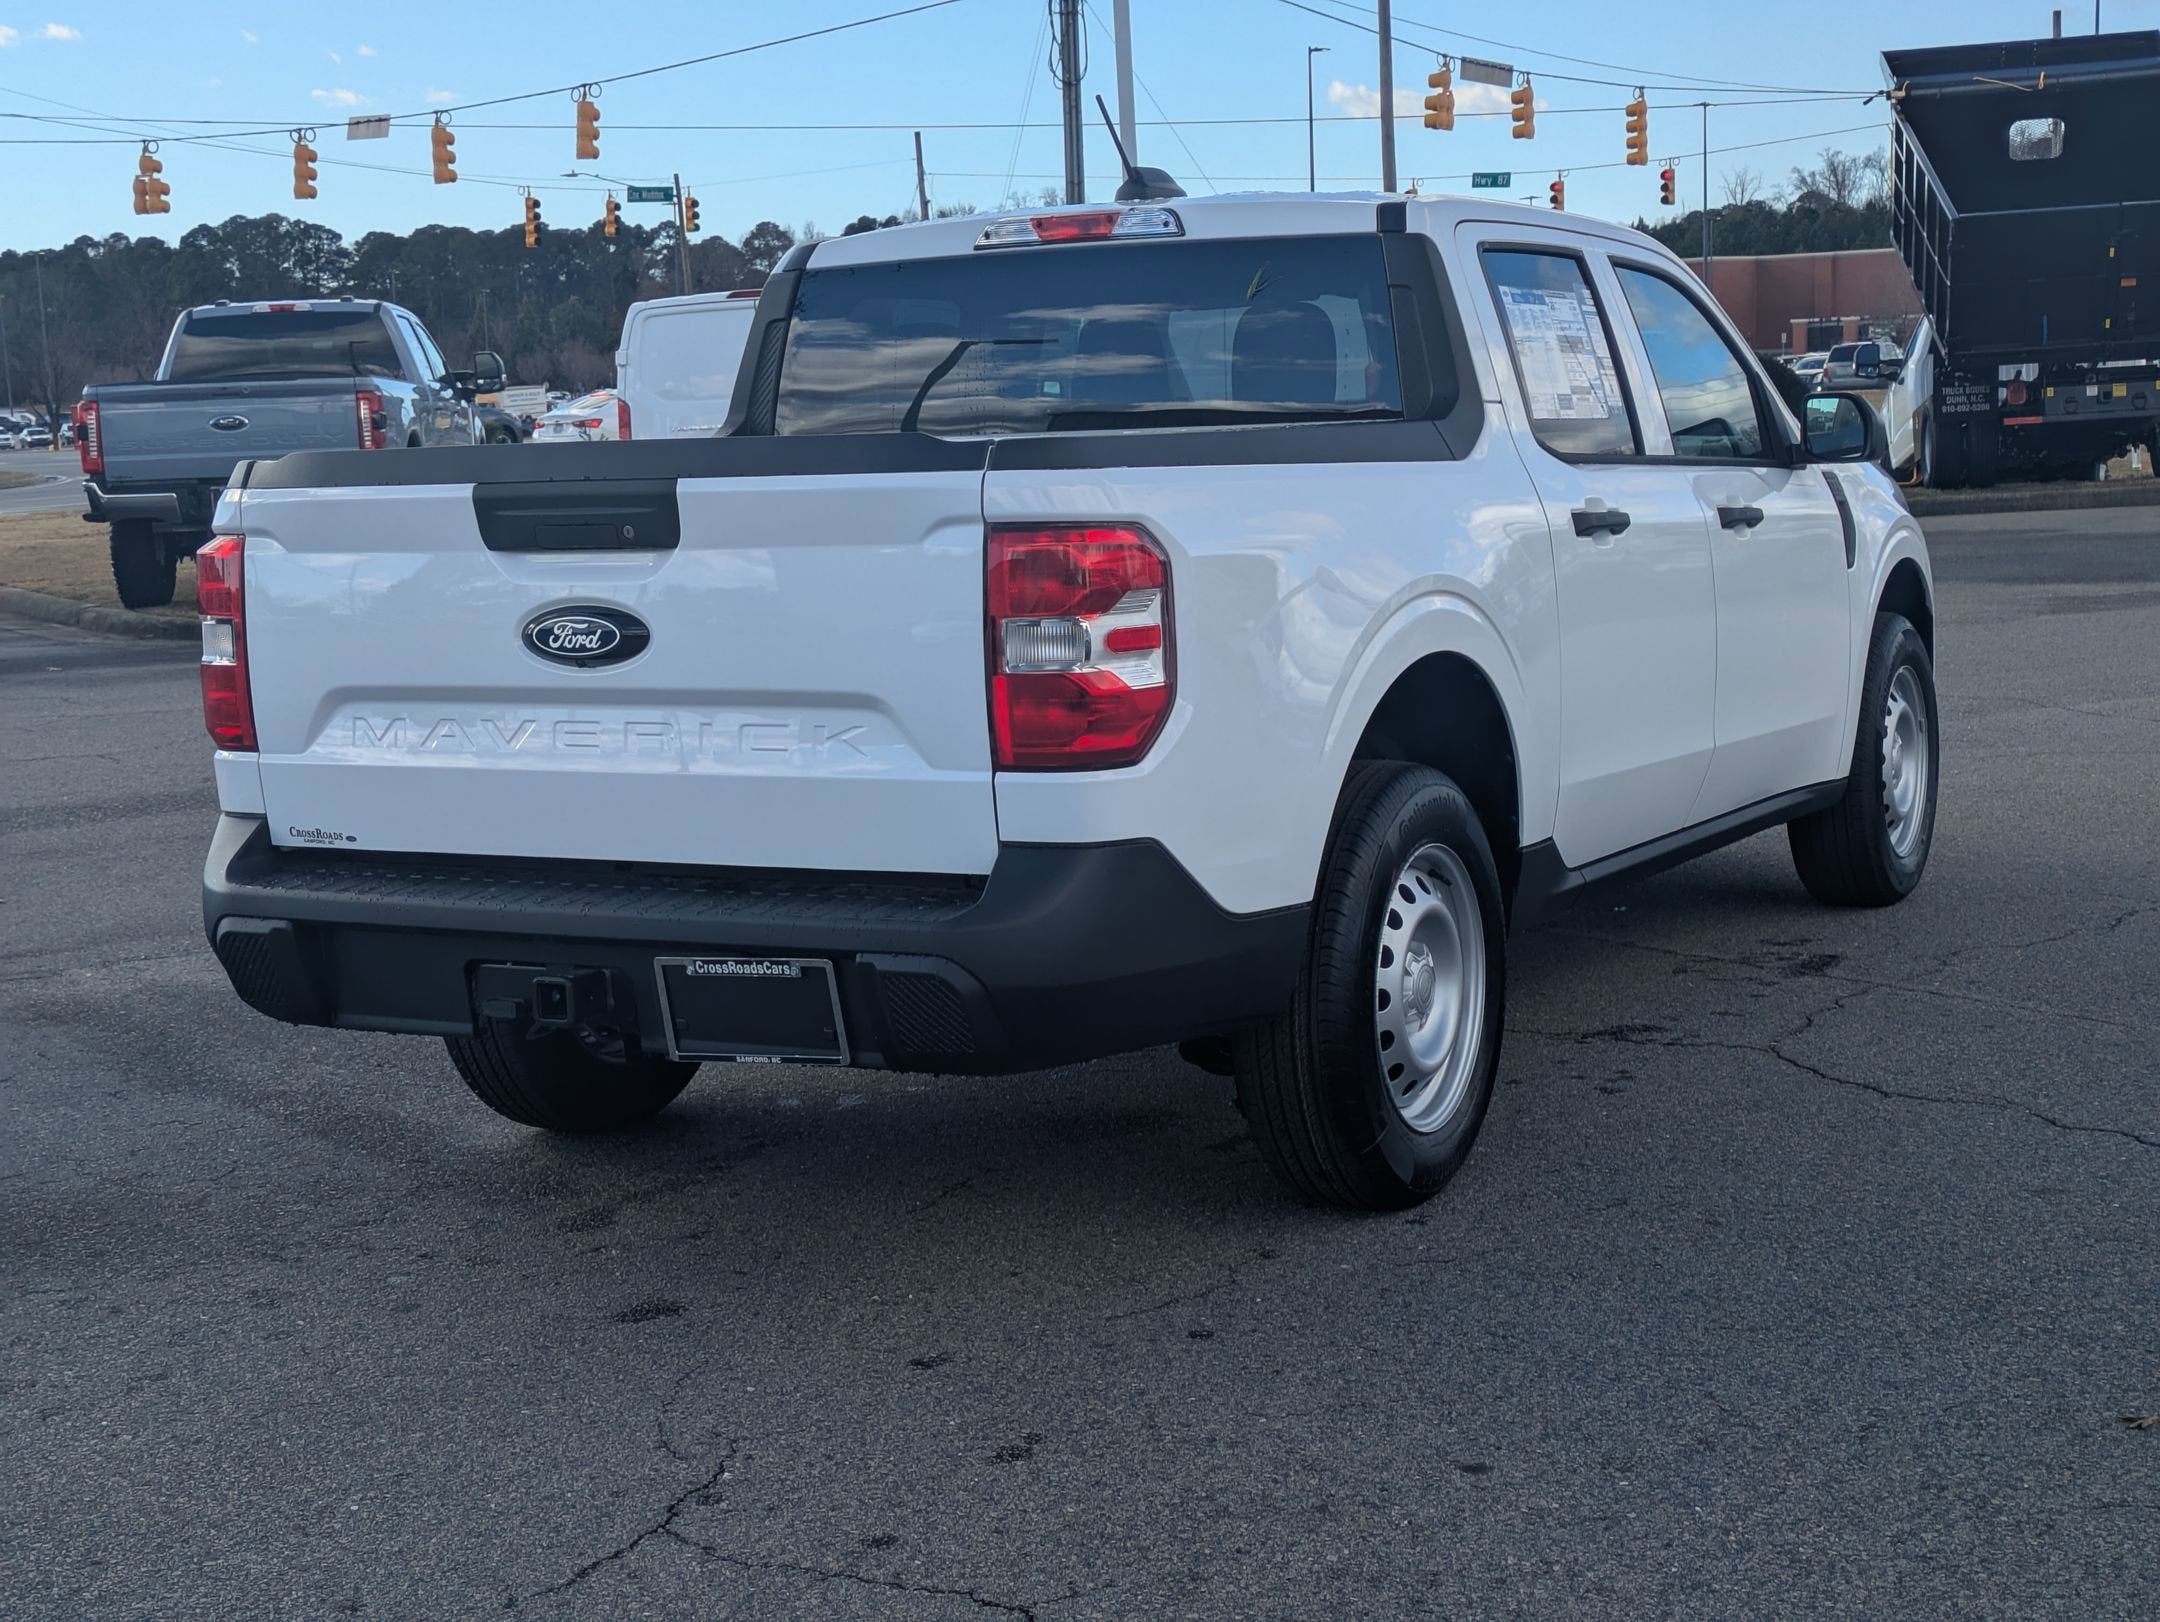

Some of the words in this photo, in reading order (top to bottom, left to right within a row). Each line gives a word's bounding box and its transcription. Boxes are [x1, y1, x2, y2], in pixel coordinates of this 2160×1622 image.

[1475, 175, 1492, 186] Hwy
[1497, 175, 1508, 185] 87
[1942, 387, 1964, 395] TRUCK
[1946, 396, 1969, 404] DUNN,
[118, 437, 241, 450] SUPER
[250, 433, 345, 446] DUTY
[549, 622, 602, 649] Ford
[352, 716, 870, 758] MAVERICK
[695, 960, 791, 975] CrossRoadsCars
